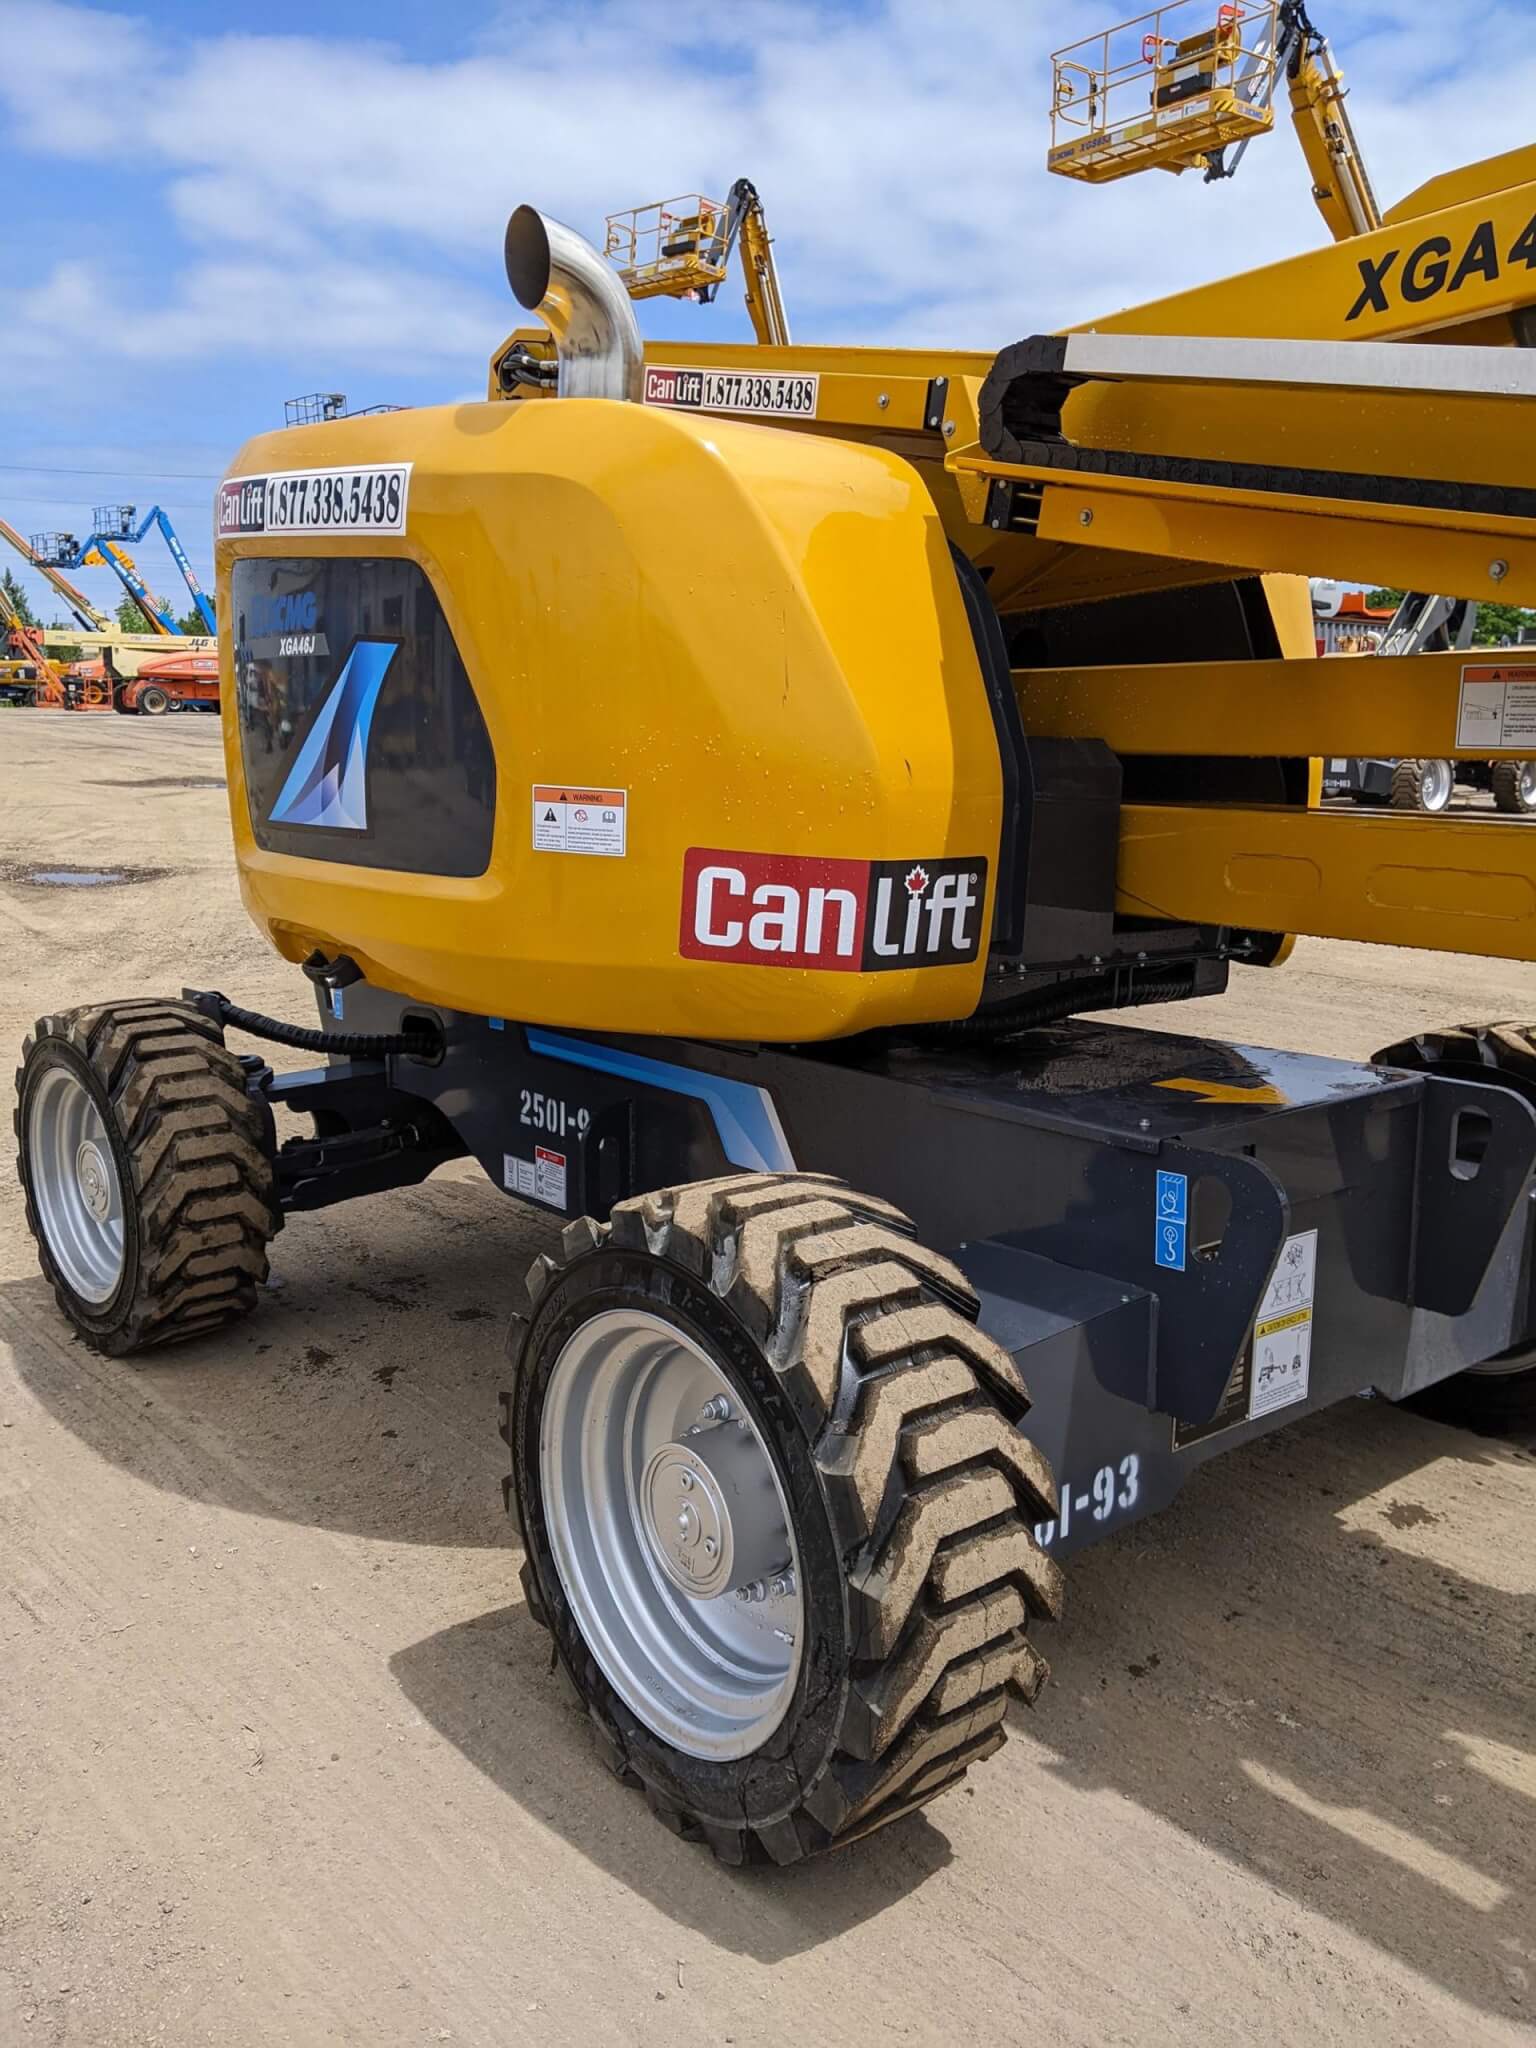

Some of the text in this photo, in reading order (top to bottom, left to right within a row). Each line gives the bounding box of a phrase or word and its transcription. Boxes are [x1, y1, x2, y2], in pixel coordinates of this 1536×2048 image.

[1344, 213, 1536, 322] XGA4
[705, 377, 813, 411] 1.877.338.5438
[267, 474, 401, 526] 1.877.338.5438
[279, 636, 316, 657] XGA46J
[573, 793, 604, 803] WARNING
